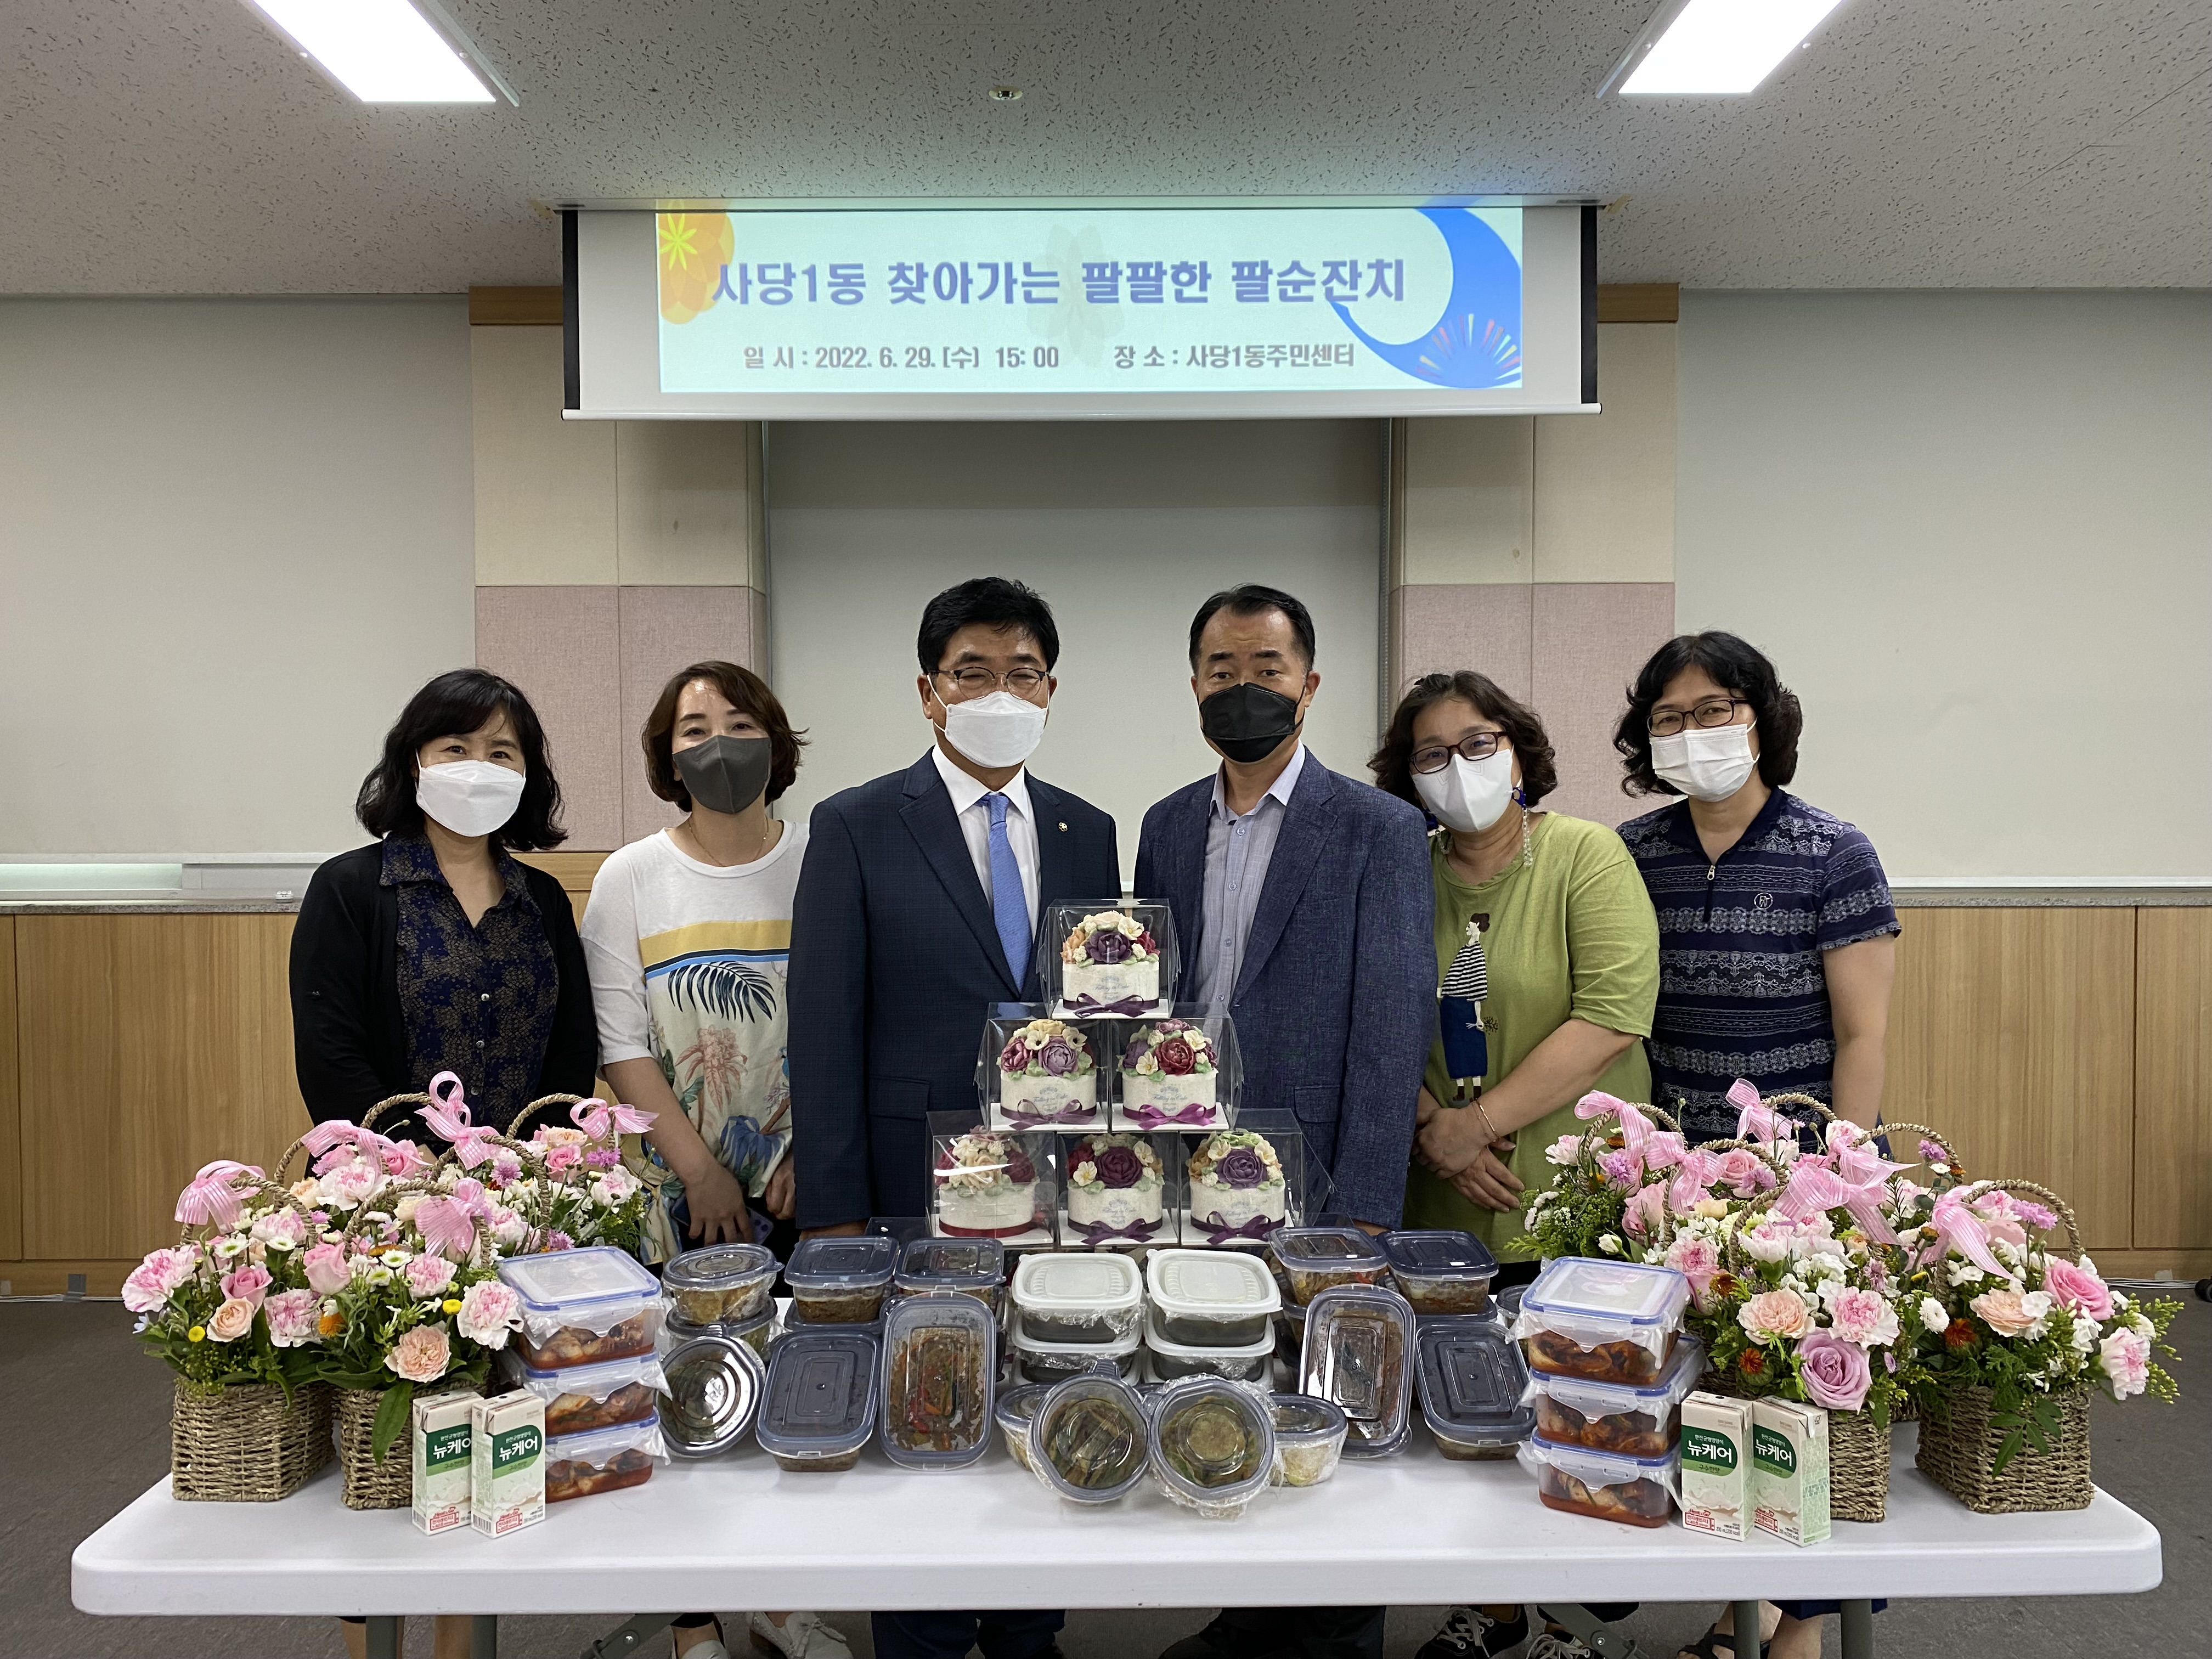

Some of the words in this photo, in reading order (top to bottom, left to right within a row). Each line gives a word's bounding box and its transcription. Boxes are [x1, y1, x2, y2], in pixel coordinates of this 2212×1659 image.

[713, 262, 867, 306] 사당1동
[888, 261, 1060, 304] 찾아가는
[1081, 260, 1212, 304] 팔팔한
[1231, 258, 1404, 303] 팔순잔치
[743, 347, 764, 369] 일
[773, 347, 794, 369] 시
[815, 346, 872, 368] 2022.
[879, 346, 898, 368] 6.
[905, 346, 936, 368] 29.
[995, 346, 1026, 368] 15:
[1033, 346, 1059, 368] 00
[1114, 345, 1136, 369] 장
[1143, 345, 1165, 367] 소
[1186, 343, 1355, 369] 사당1동주민센터
[499, 1435, 538, 1462] 뉴케어
[1687, 1440, 1733, 1464] 뉴케어
[1755, 1438, 1792, 1467] 뉴케어
